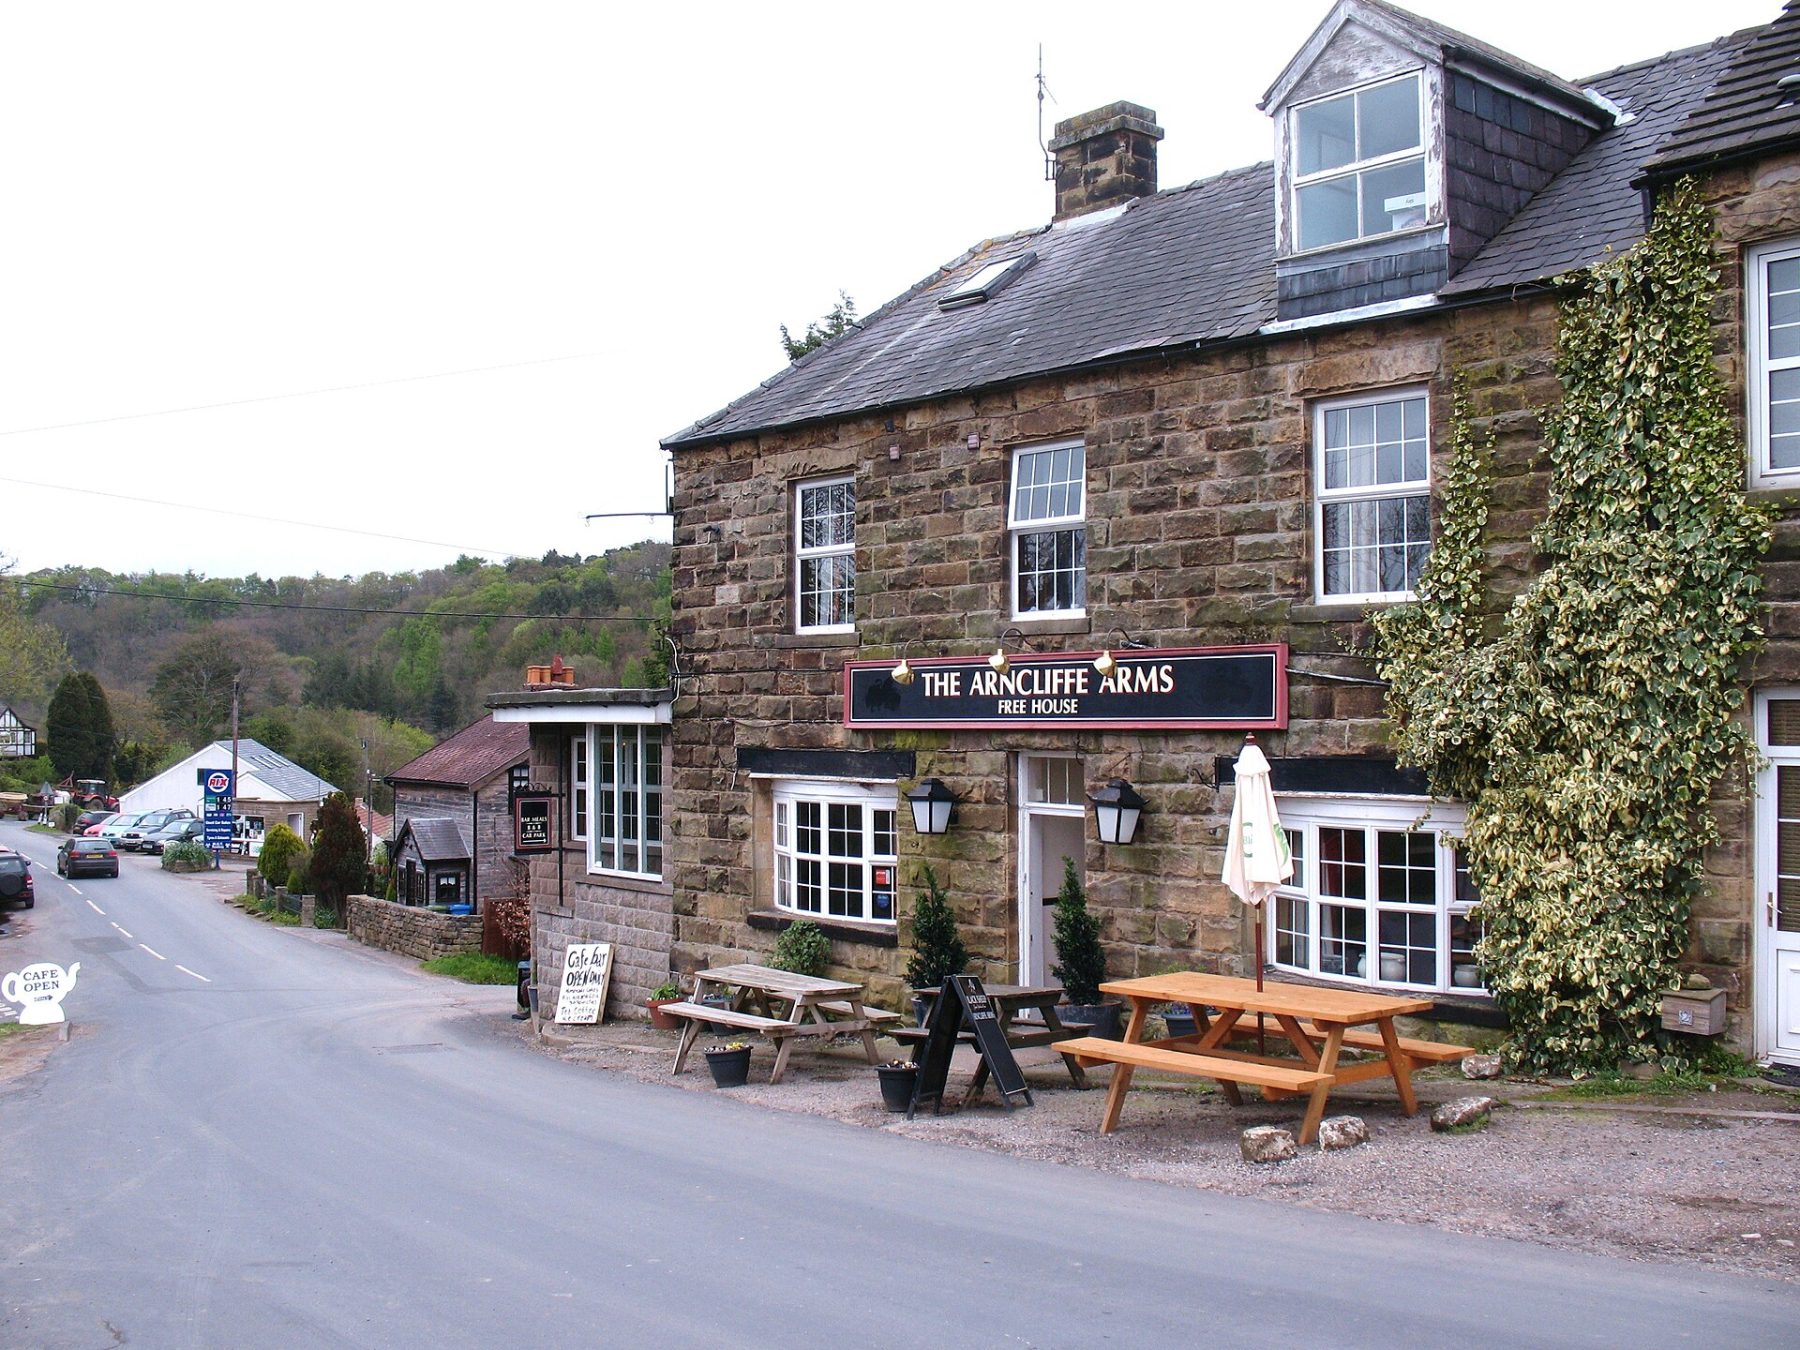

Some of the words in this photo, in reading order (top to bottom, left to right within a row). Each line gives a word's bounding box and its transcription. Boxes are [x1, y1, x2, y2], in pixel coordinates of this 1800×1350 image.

[921, 672, 961, 697] THE
[969, 668, 1088, 696] ARNCLIFFE
[1098, 664, 1174, 694] ARMS
[998, 700, 1027, 714] FREE
[1031, 699, 1078, 714] HOUSE
[208, 777, 228, 787] RIX
[568, 948, 588, 969] Cafe
[590, 946, 607, 967] bar
[23, 969, 59, 981] CAFE
[566, 967, 591, 987] OPEN
[24, 980, 60, 992] OPEN
